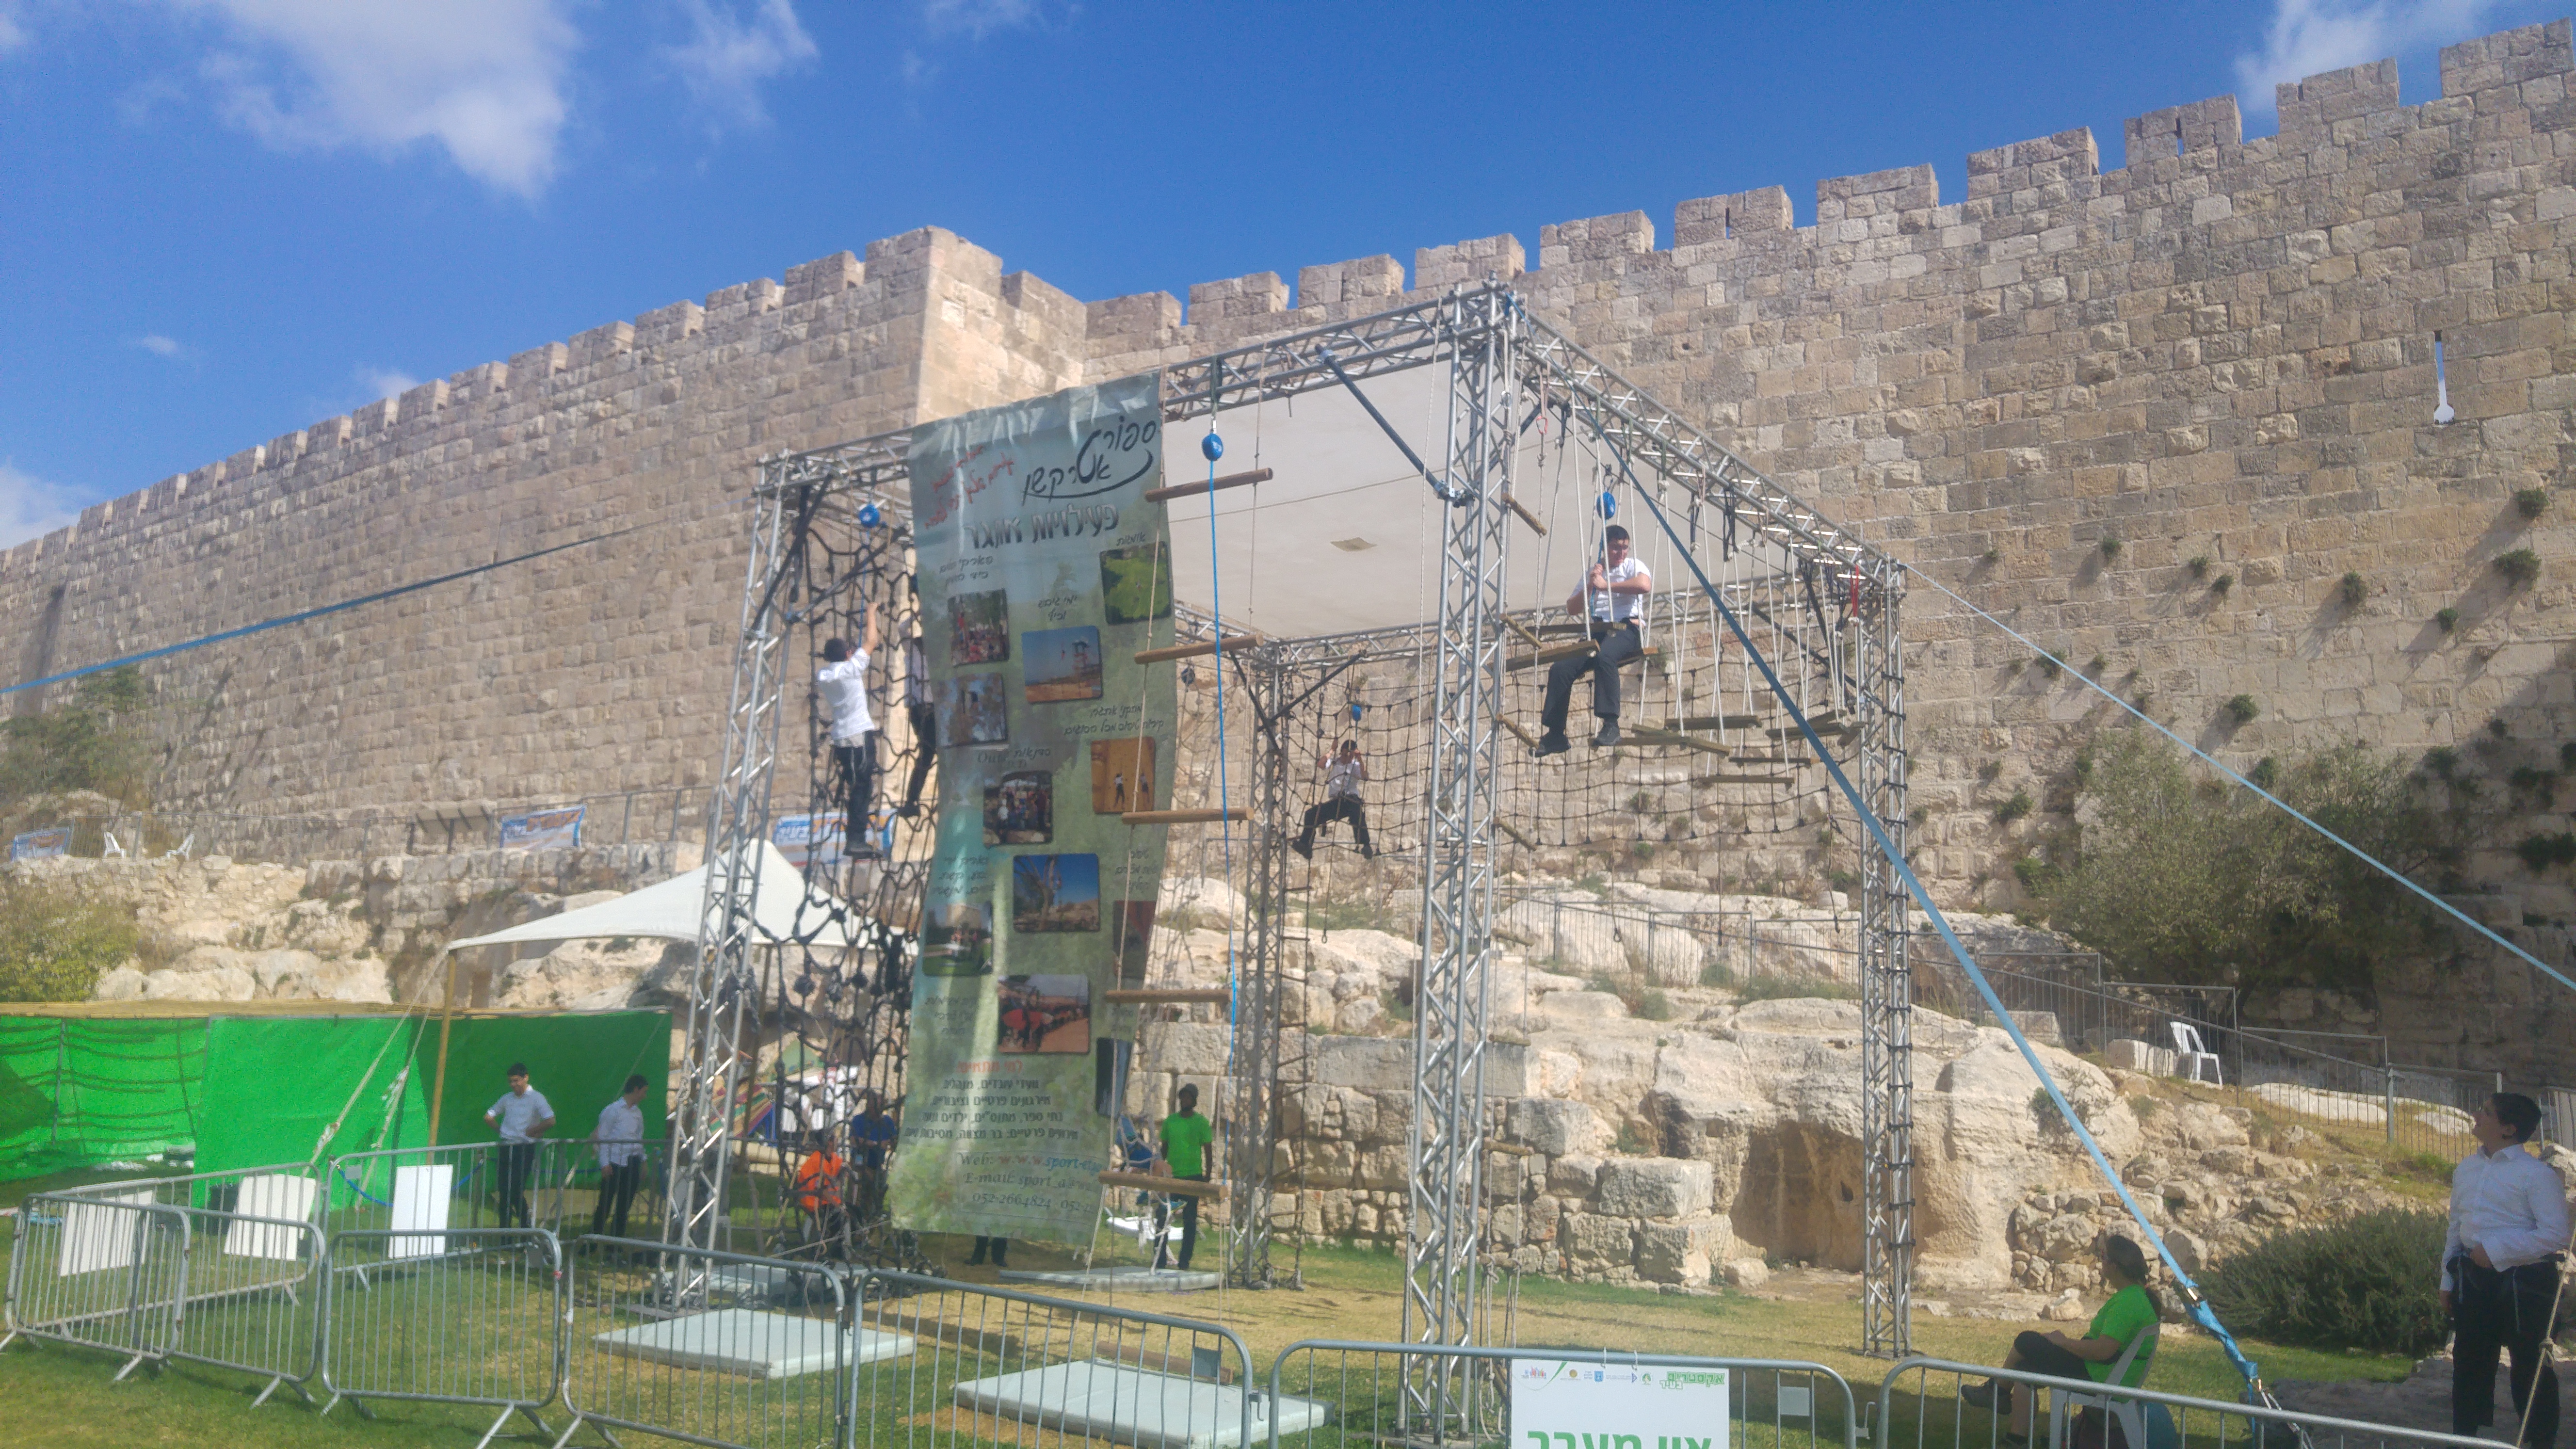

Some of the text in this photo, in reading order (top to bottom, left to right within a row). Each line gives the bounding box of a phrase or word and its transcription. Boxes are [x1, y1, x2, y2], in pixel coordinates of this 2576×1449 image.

[963, 503, 1120, 549] פעילויות אתגר
[1659, 1380, 1683, 1390] בעיר
[1667, 1371, 1725, 1387] אקסטרים
